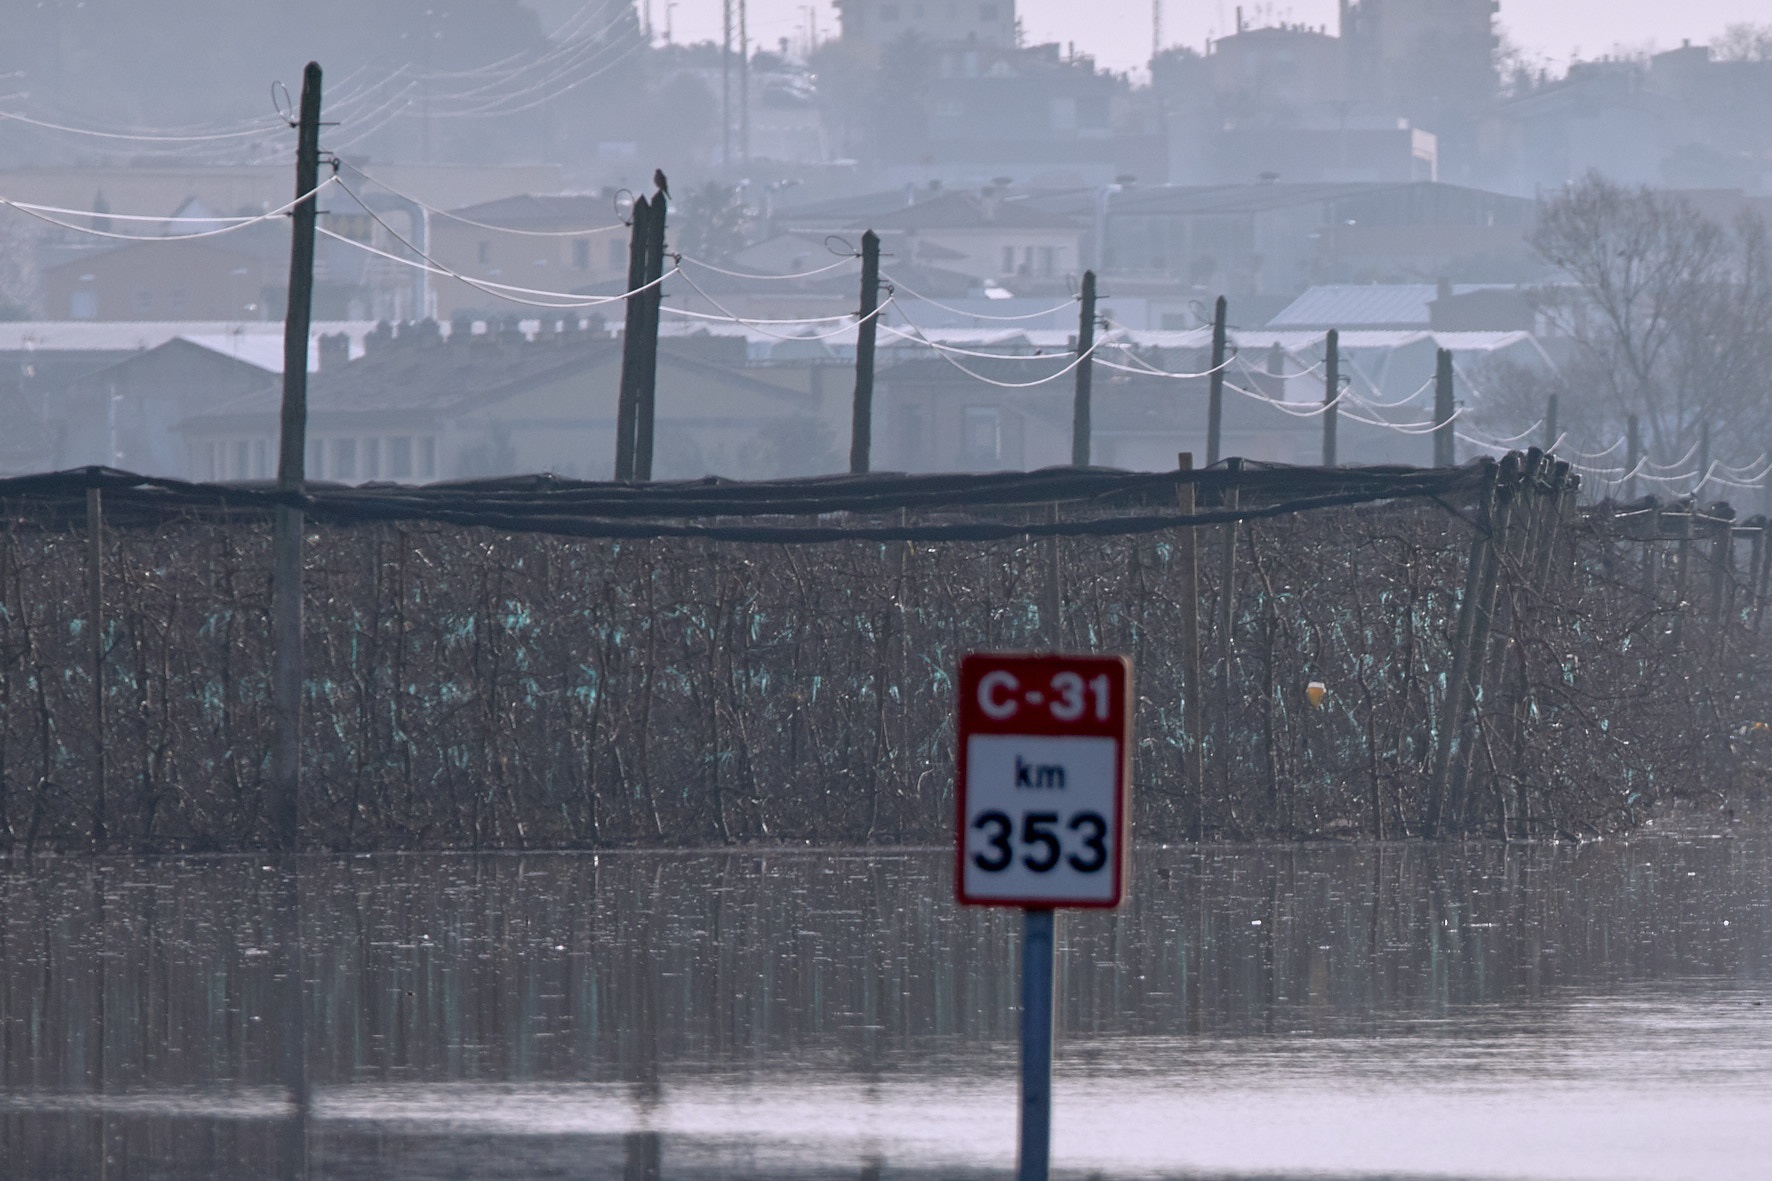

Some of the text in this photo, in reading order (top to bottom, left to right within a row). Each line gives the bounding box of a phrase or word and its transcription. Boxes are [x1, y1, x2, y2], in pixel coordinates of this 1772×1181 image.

[977, 670, 1111, 721] C-31
[1015, 755, 1067, 789] km
[973, 809, 1108, 874] 353
